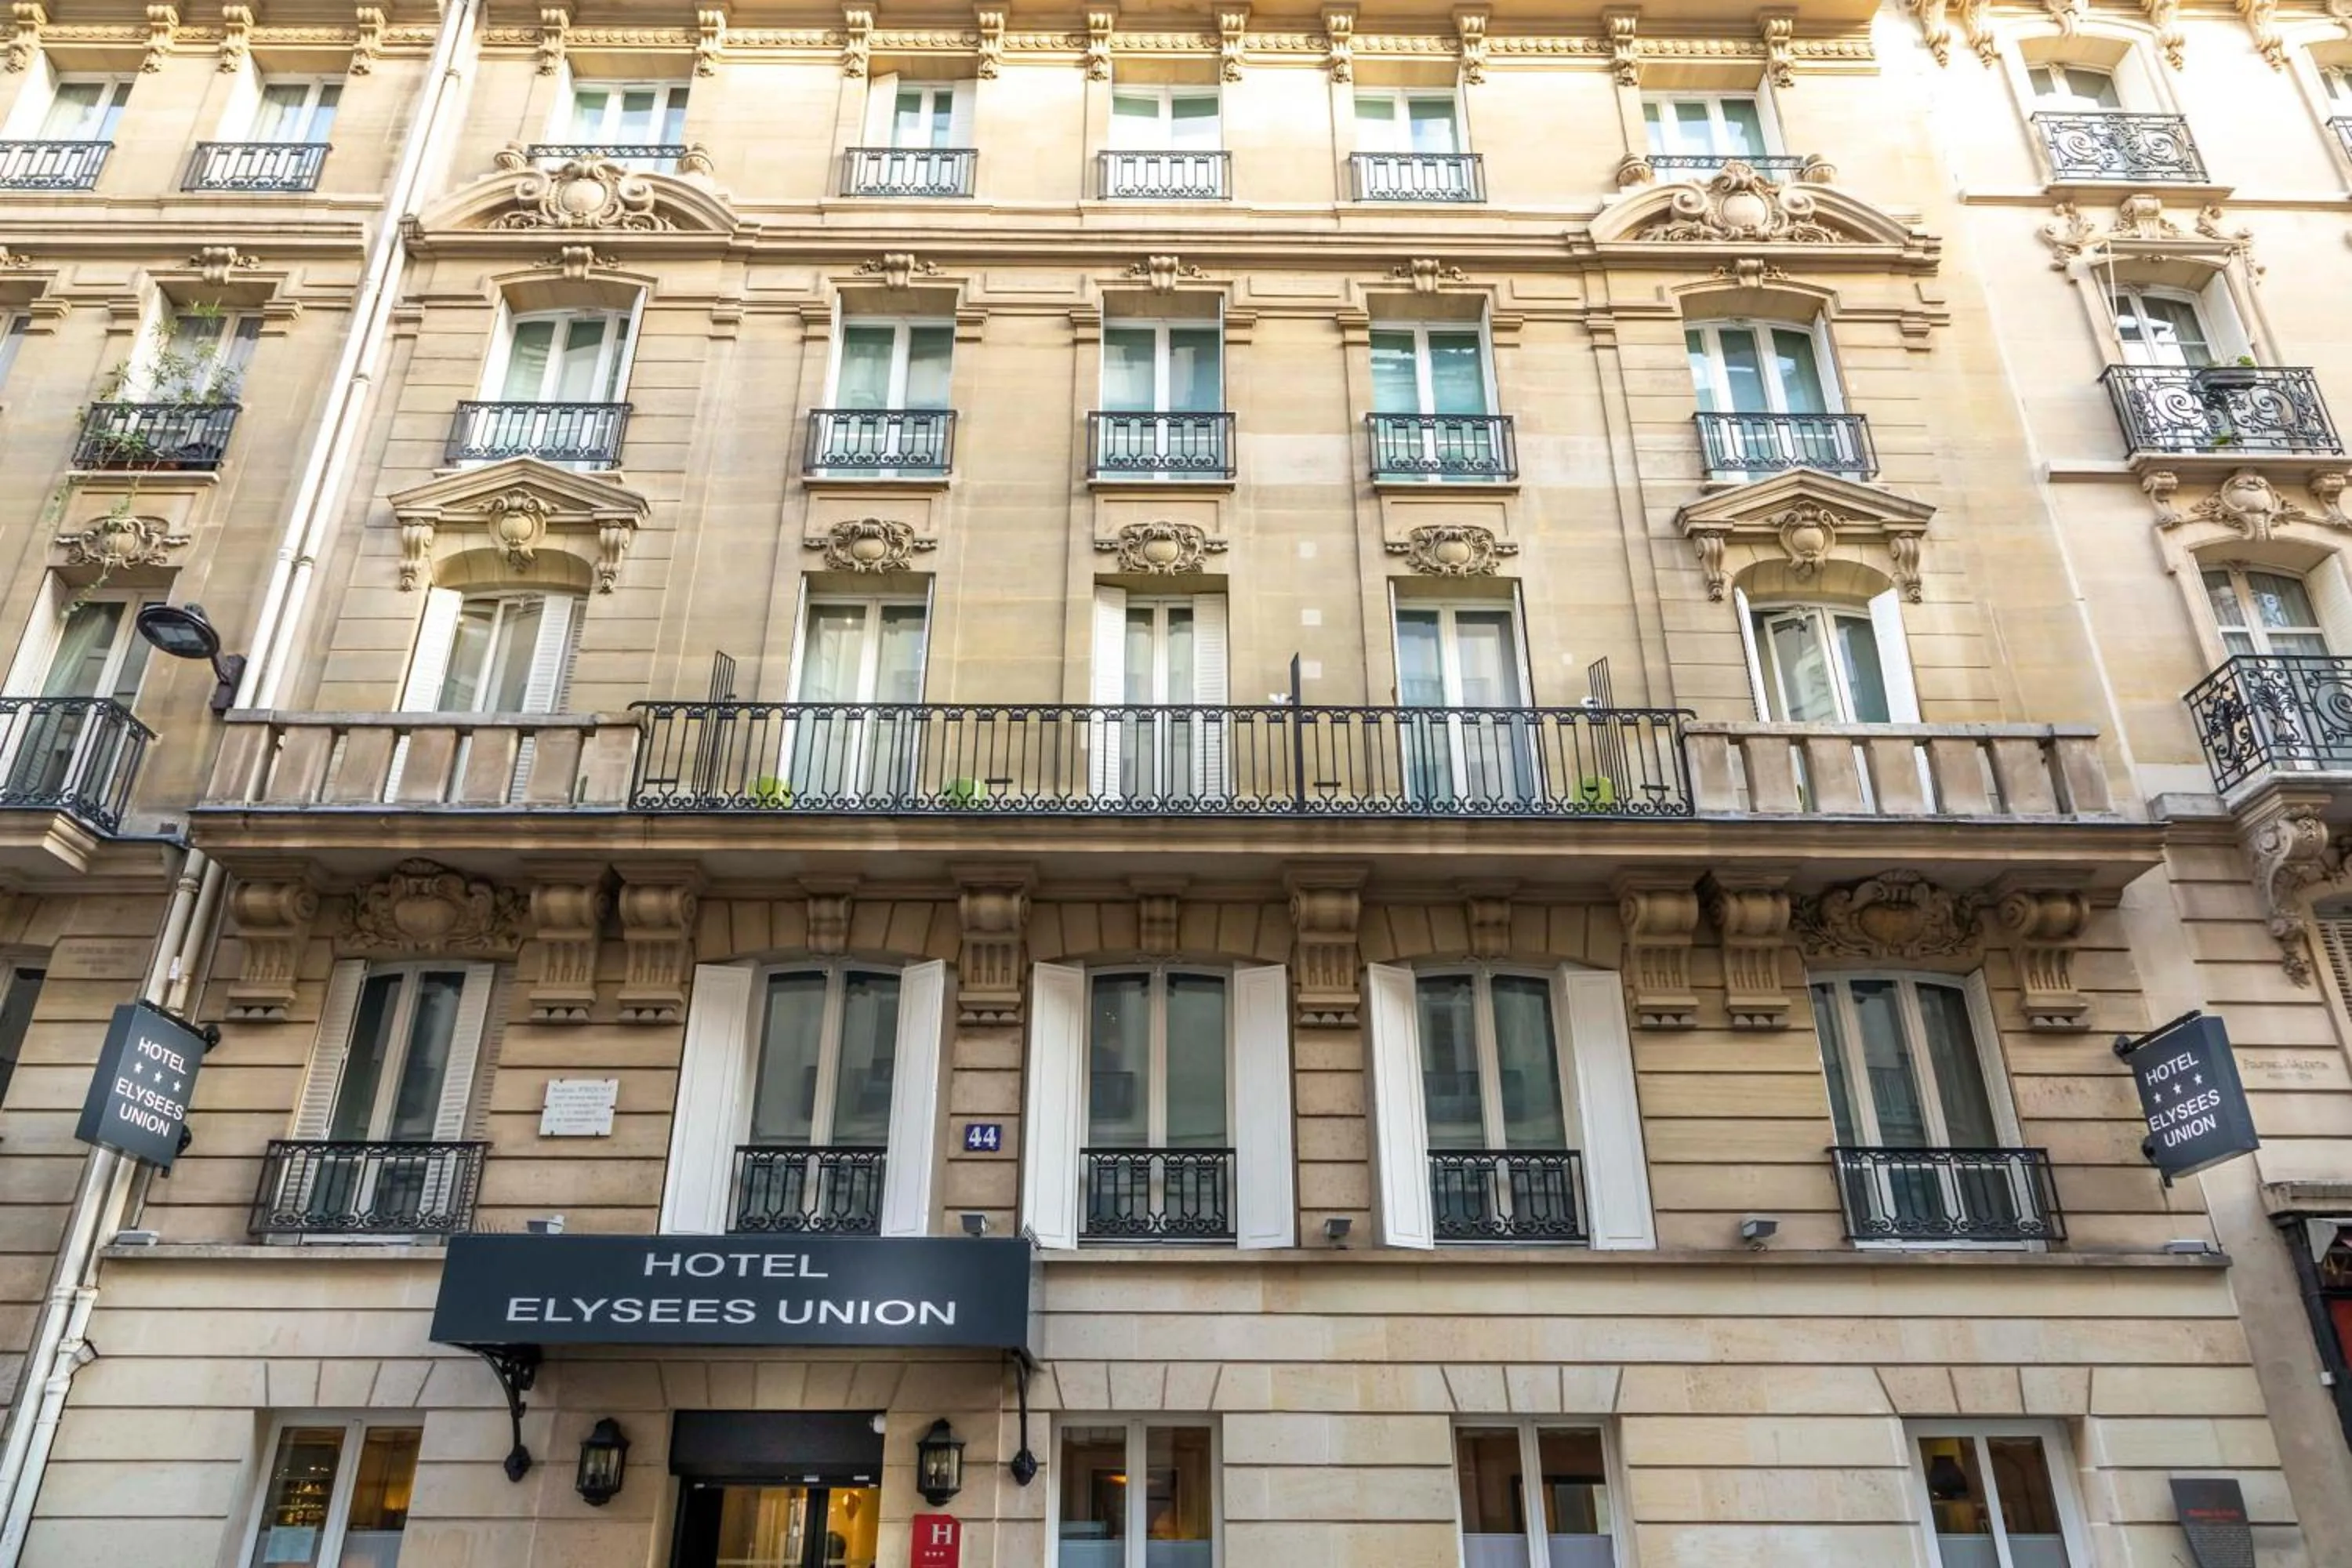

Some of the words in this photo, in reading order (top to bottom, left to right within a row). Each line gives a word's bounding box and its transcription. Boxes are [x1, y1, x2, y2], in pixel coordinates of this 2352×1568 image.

[137, 1037, 187, 1075] HOTEL
[2145, 1051, 2198, 1086] HOTEL
[115, 1077, 183, 1120] ELYSEES
[2149, 1089, 2220, 1131] ELYSEES
[119, 1103, 169, 1137] UNION
[968, 1127, 996, 1146] 44
[2164, 1114, 2216, 1147] UNION
[644, 1252, 828, 1277] HOTEL
[505, 1298, 756, 1325] ELYSEES
[776, 1299, 956, 1327] UNION
[931, 1523, 954, 1545] H
